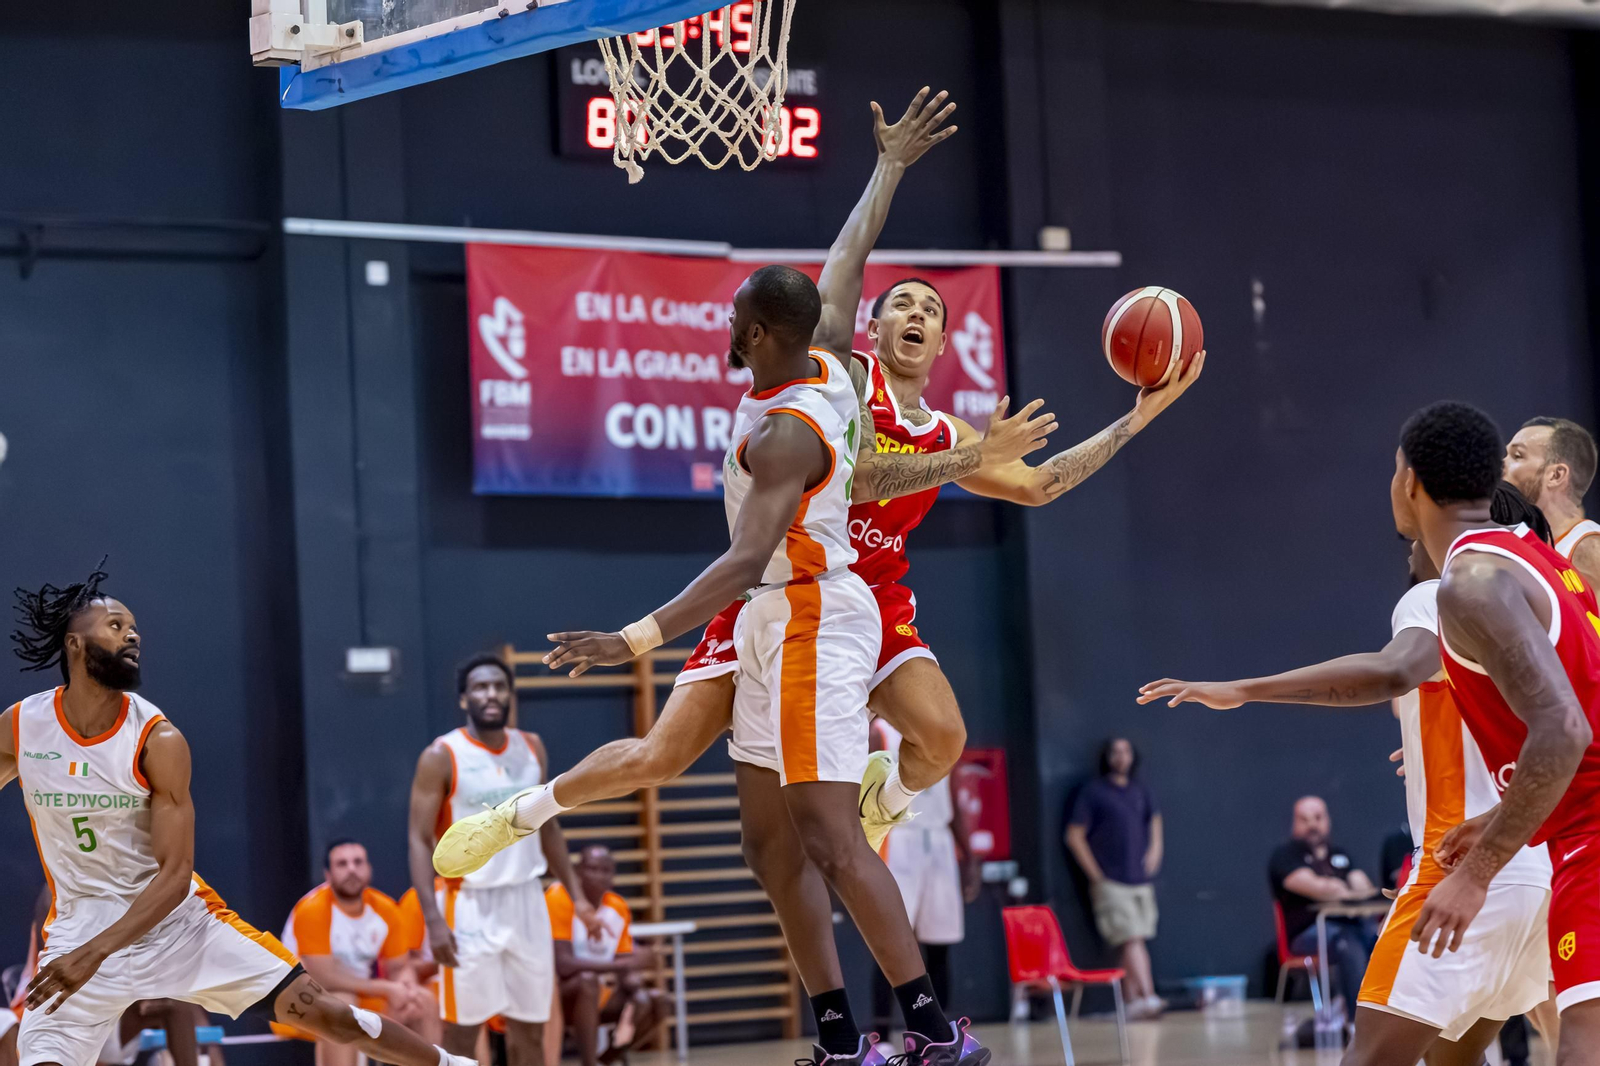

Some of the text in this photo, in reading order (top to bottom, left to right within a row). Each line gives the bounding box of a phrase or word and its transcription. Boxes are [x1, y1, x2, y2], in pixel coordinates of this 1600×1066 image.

[570, 57, 648, 87] LOL
[575, 291, 734, 332] EN LA CANCH
[561, 346, 594, 376] EN
[598, 348, 632, 378] LA
[634, 349, 721, 383] GRADA
[605, 401, 698, 450] CON
[31, 789, 140, 809] ÔTE D'IVOIRE
[72, 816, 97, 853] 5
